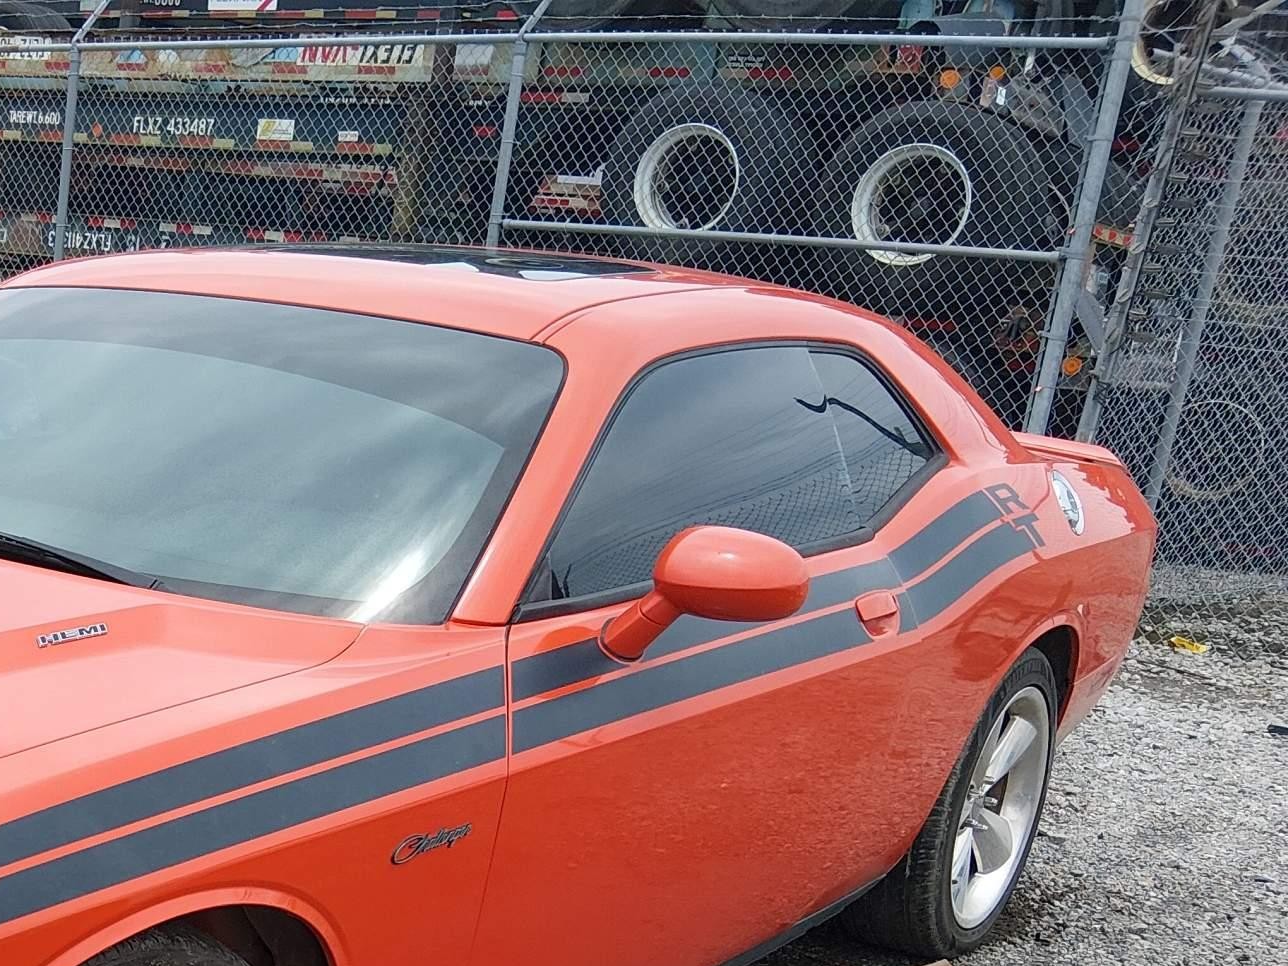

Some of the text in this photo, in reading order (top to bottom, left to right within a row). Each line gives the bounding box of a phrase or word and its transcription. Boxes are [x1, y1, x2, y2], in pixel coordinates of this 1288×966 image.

[133, 116, 214, 136] FLXZ 433487
[36, 622, 109, 648] HEMI
